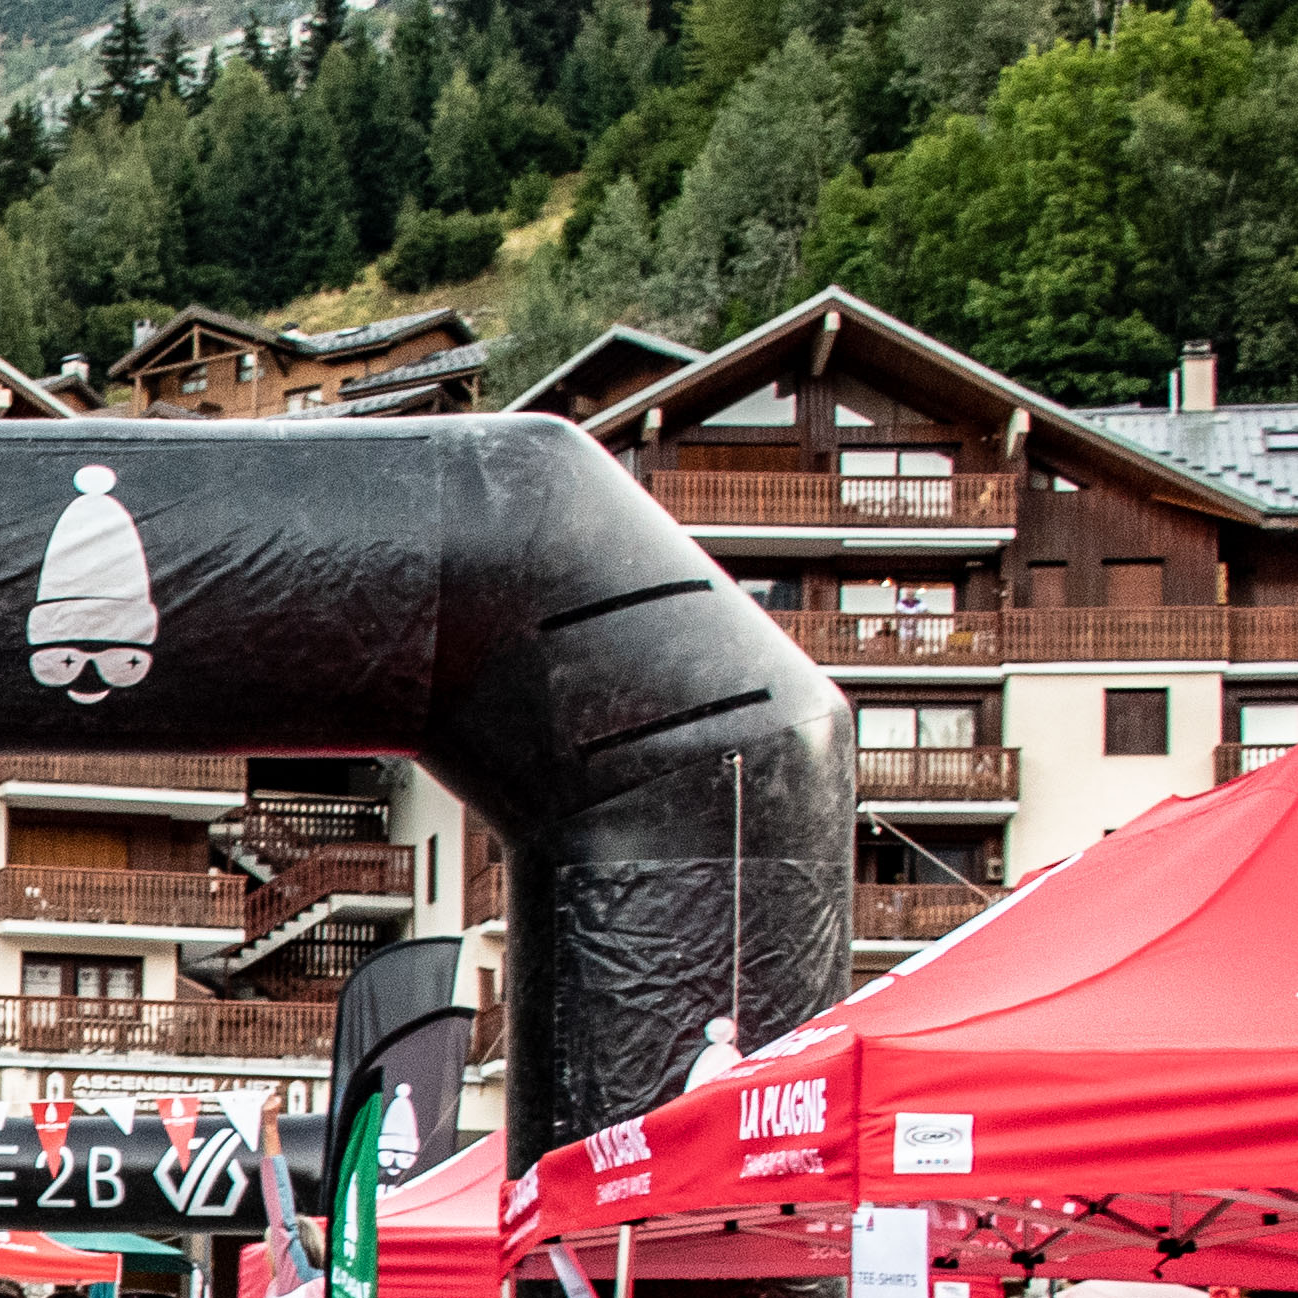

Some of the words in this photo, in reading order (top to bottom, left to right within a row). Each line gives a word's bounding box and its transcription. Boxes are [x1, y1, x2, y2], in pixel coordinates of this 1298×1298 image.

[72, 1073, 215, 1092] ASCENSEUR
[739, 1089, 760, 1140] LA
[762, 1077, 827, 1138] PLAGNE
